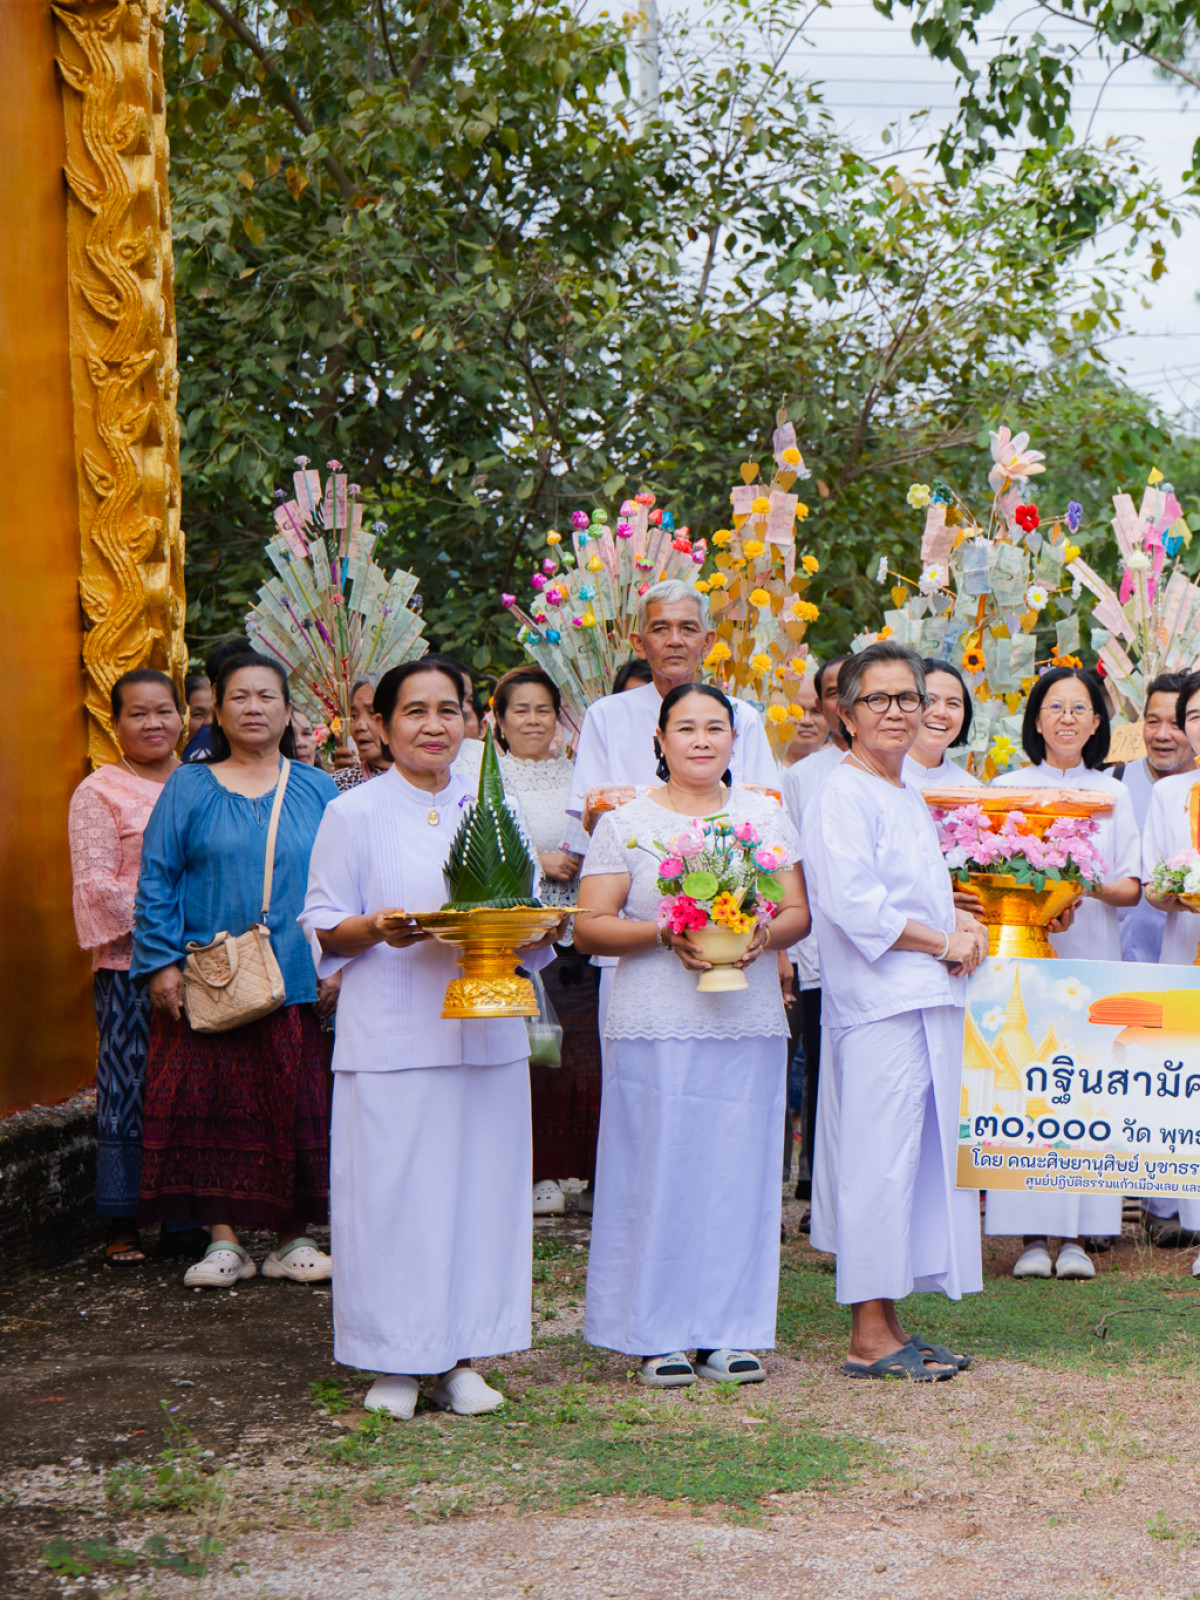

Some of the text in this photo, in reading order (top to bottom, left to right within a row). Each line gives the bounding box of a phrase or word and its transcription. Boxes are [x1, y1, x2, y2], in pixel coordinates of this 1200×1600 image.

[974, 1115, 1112, 1144] ๓๐,๐๐๐
[1122, 1117, 1151, 1144] วัด
[972, 1148, 1003, 1168] โดย
[1008, 1152, 1140, 1177] คณะศิษยานุศิษย์
[1025, 1174, 1180, 1193] ศูนย์ปฏิบัติธรรมแก้วเมืองเลย
